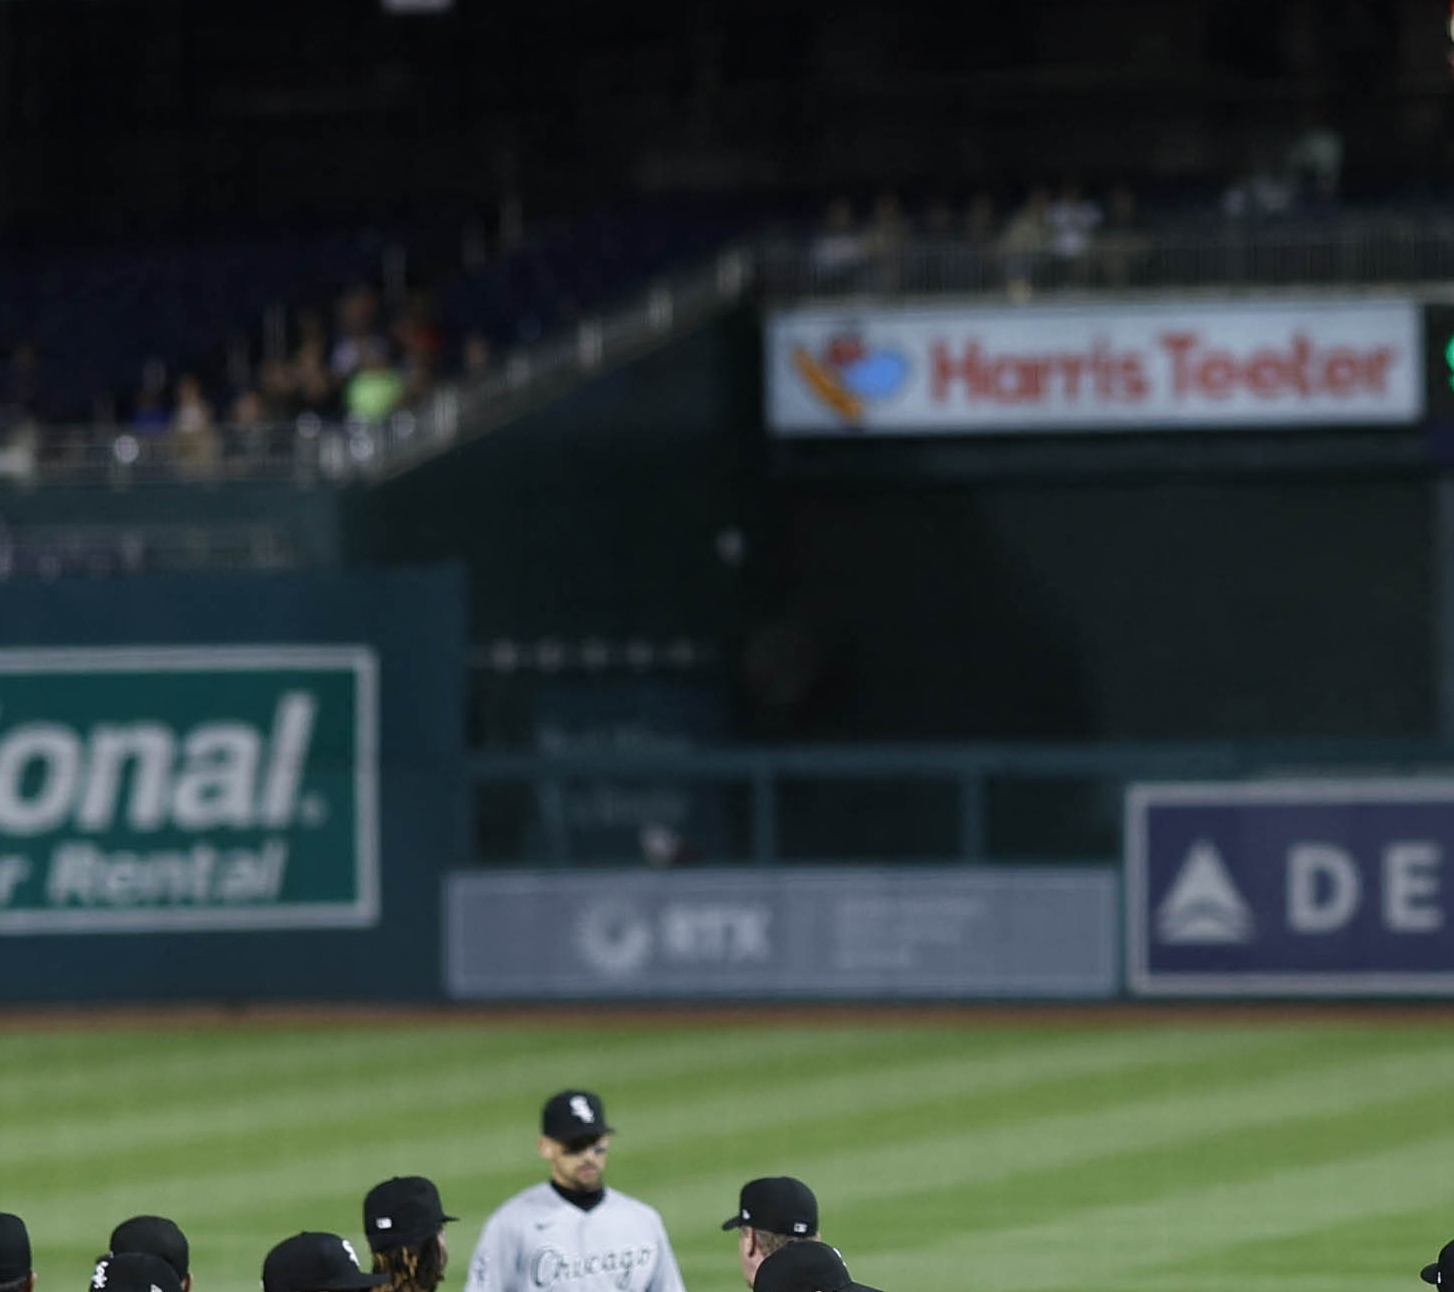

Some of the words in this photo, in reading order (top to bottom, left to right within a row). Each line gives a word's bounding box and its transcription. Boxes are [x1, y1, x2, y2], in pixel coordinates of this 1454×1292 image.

[928, 334, 1152, 403] Harris
[1158, 329, 1399, 399] Teeter
[48, 839, 288, 908] Rental
[530, 1246, 653, 1291] Chicago
